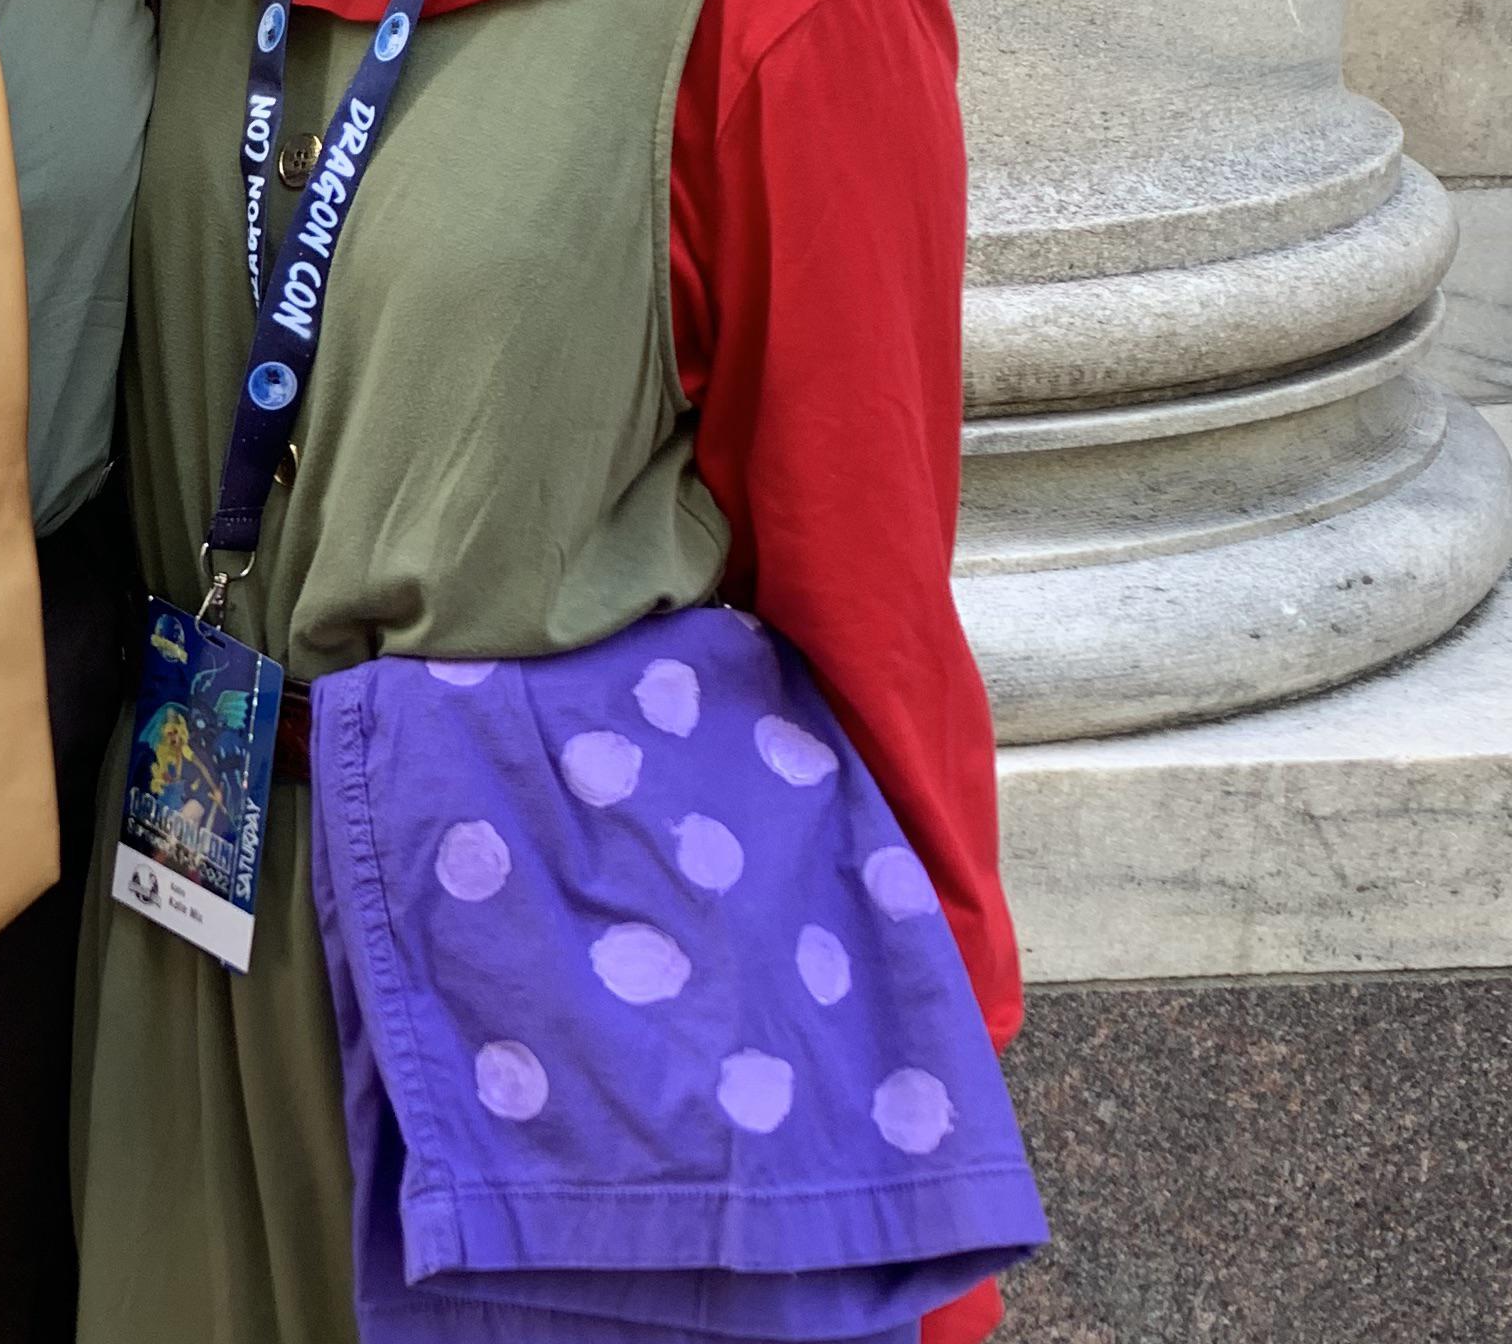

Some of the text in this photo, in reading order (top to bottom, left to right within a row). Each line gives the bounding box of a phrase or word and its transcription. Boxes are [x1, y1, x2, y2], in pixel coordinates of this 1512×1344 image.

[244, 94, 277, 308] RAGON CON
[272, 97, 376, 340] DRAGON CON
[237, 798, 261, 903] SATURDAY
